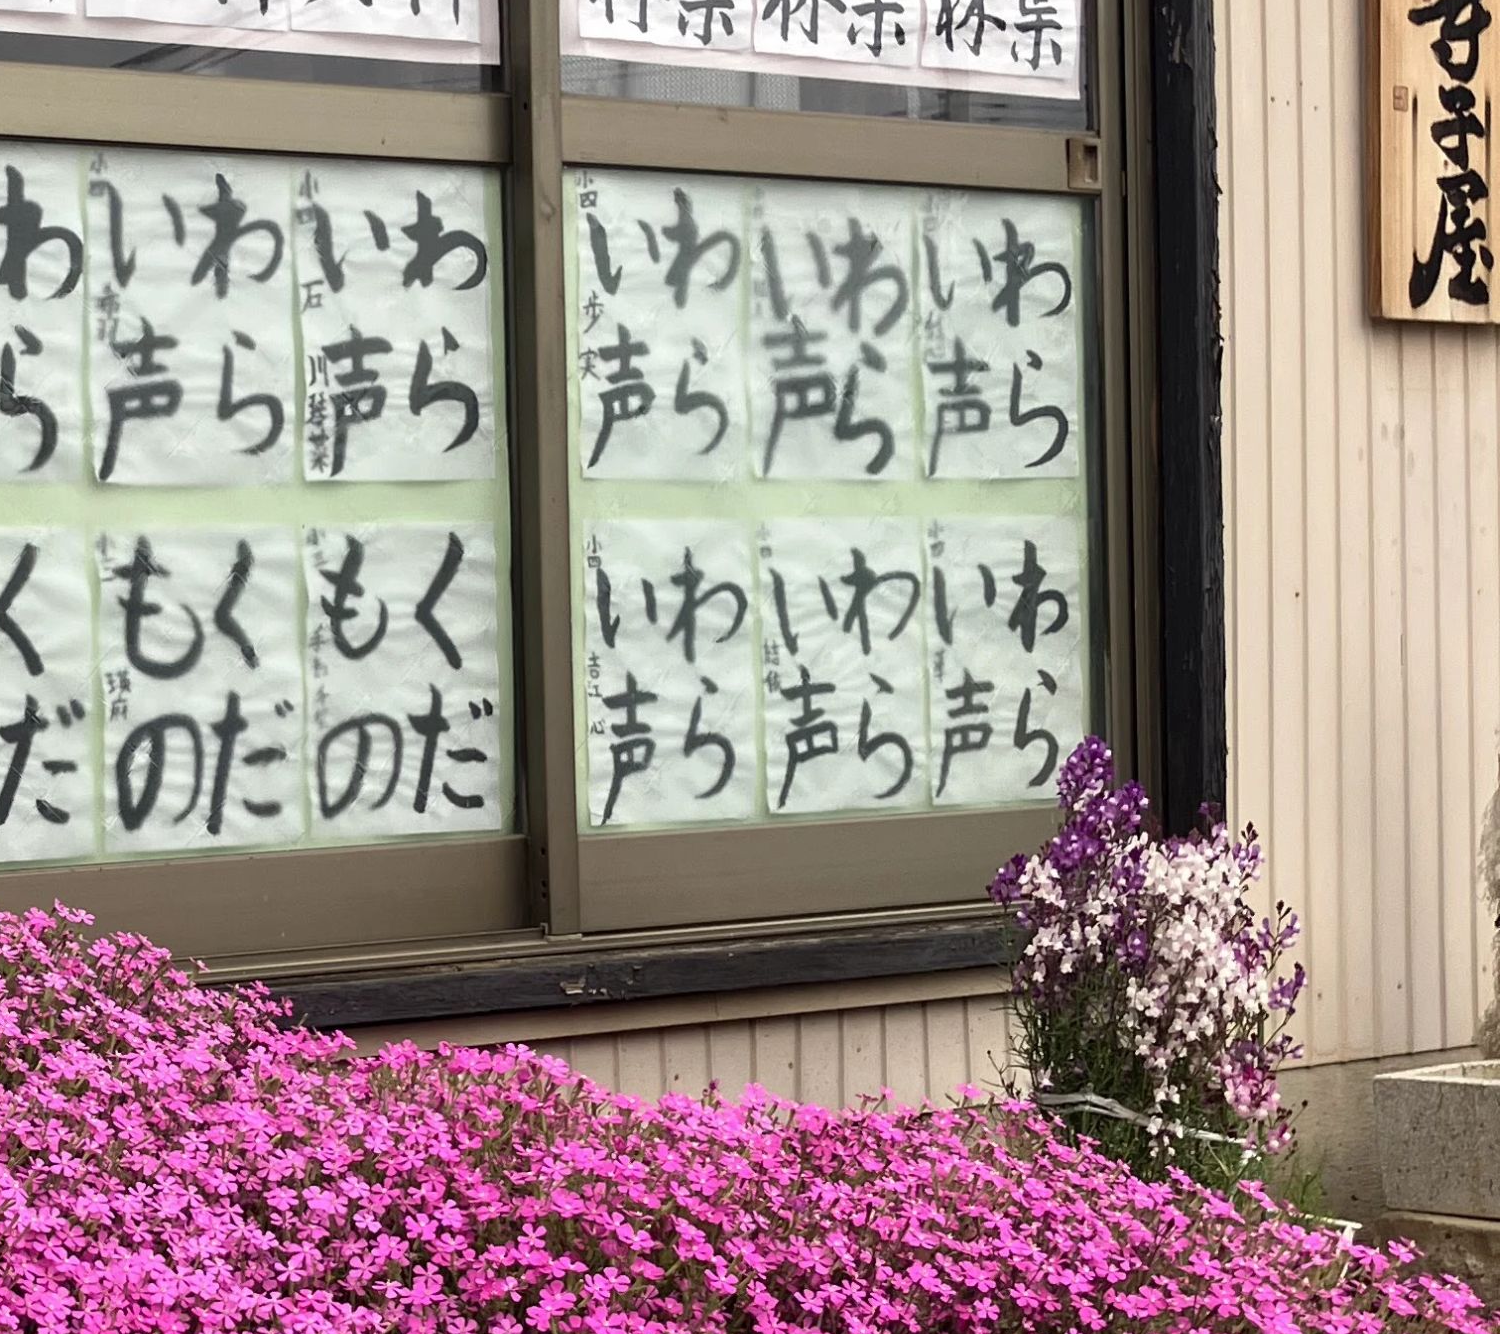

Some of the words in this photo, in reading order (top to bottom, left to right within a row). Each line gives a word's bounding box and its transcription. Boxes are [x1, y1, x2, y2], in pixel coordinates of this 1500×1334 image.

[99, 181, 185, 481] い声
[191, 173, 284, 455] わら
[314, 203, 393, 476] い声
[401, 190, 487, 452] わら
[585, 212, 660, 470] い声
[661, 187, 741, 455] わら
[759, 224, 837, 476] い声
[831, 217, 910, 475] わら
[924, 235, 992, 478] い声
[992, 218, 1072, 469] わら
[112, 535, 204, 831] もの
[207, 539, 295, 835] くだ
[317, 534, 402, 818] もの
[407, 532, 493, 813] くだ
[596, 567, 658, 826] い声
[666, 546, 748, 799] わら
[769, 567, 839, 809] い声
[841, 547, 920, 799] わら
[933, 565, 996, 798] い声
[1008, 539, 1069, 788] わら
